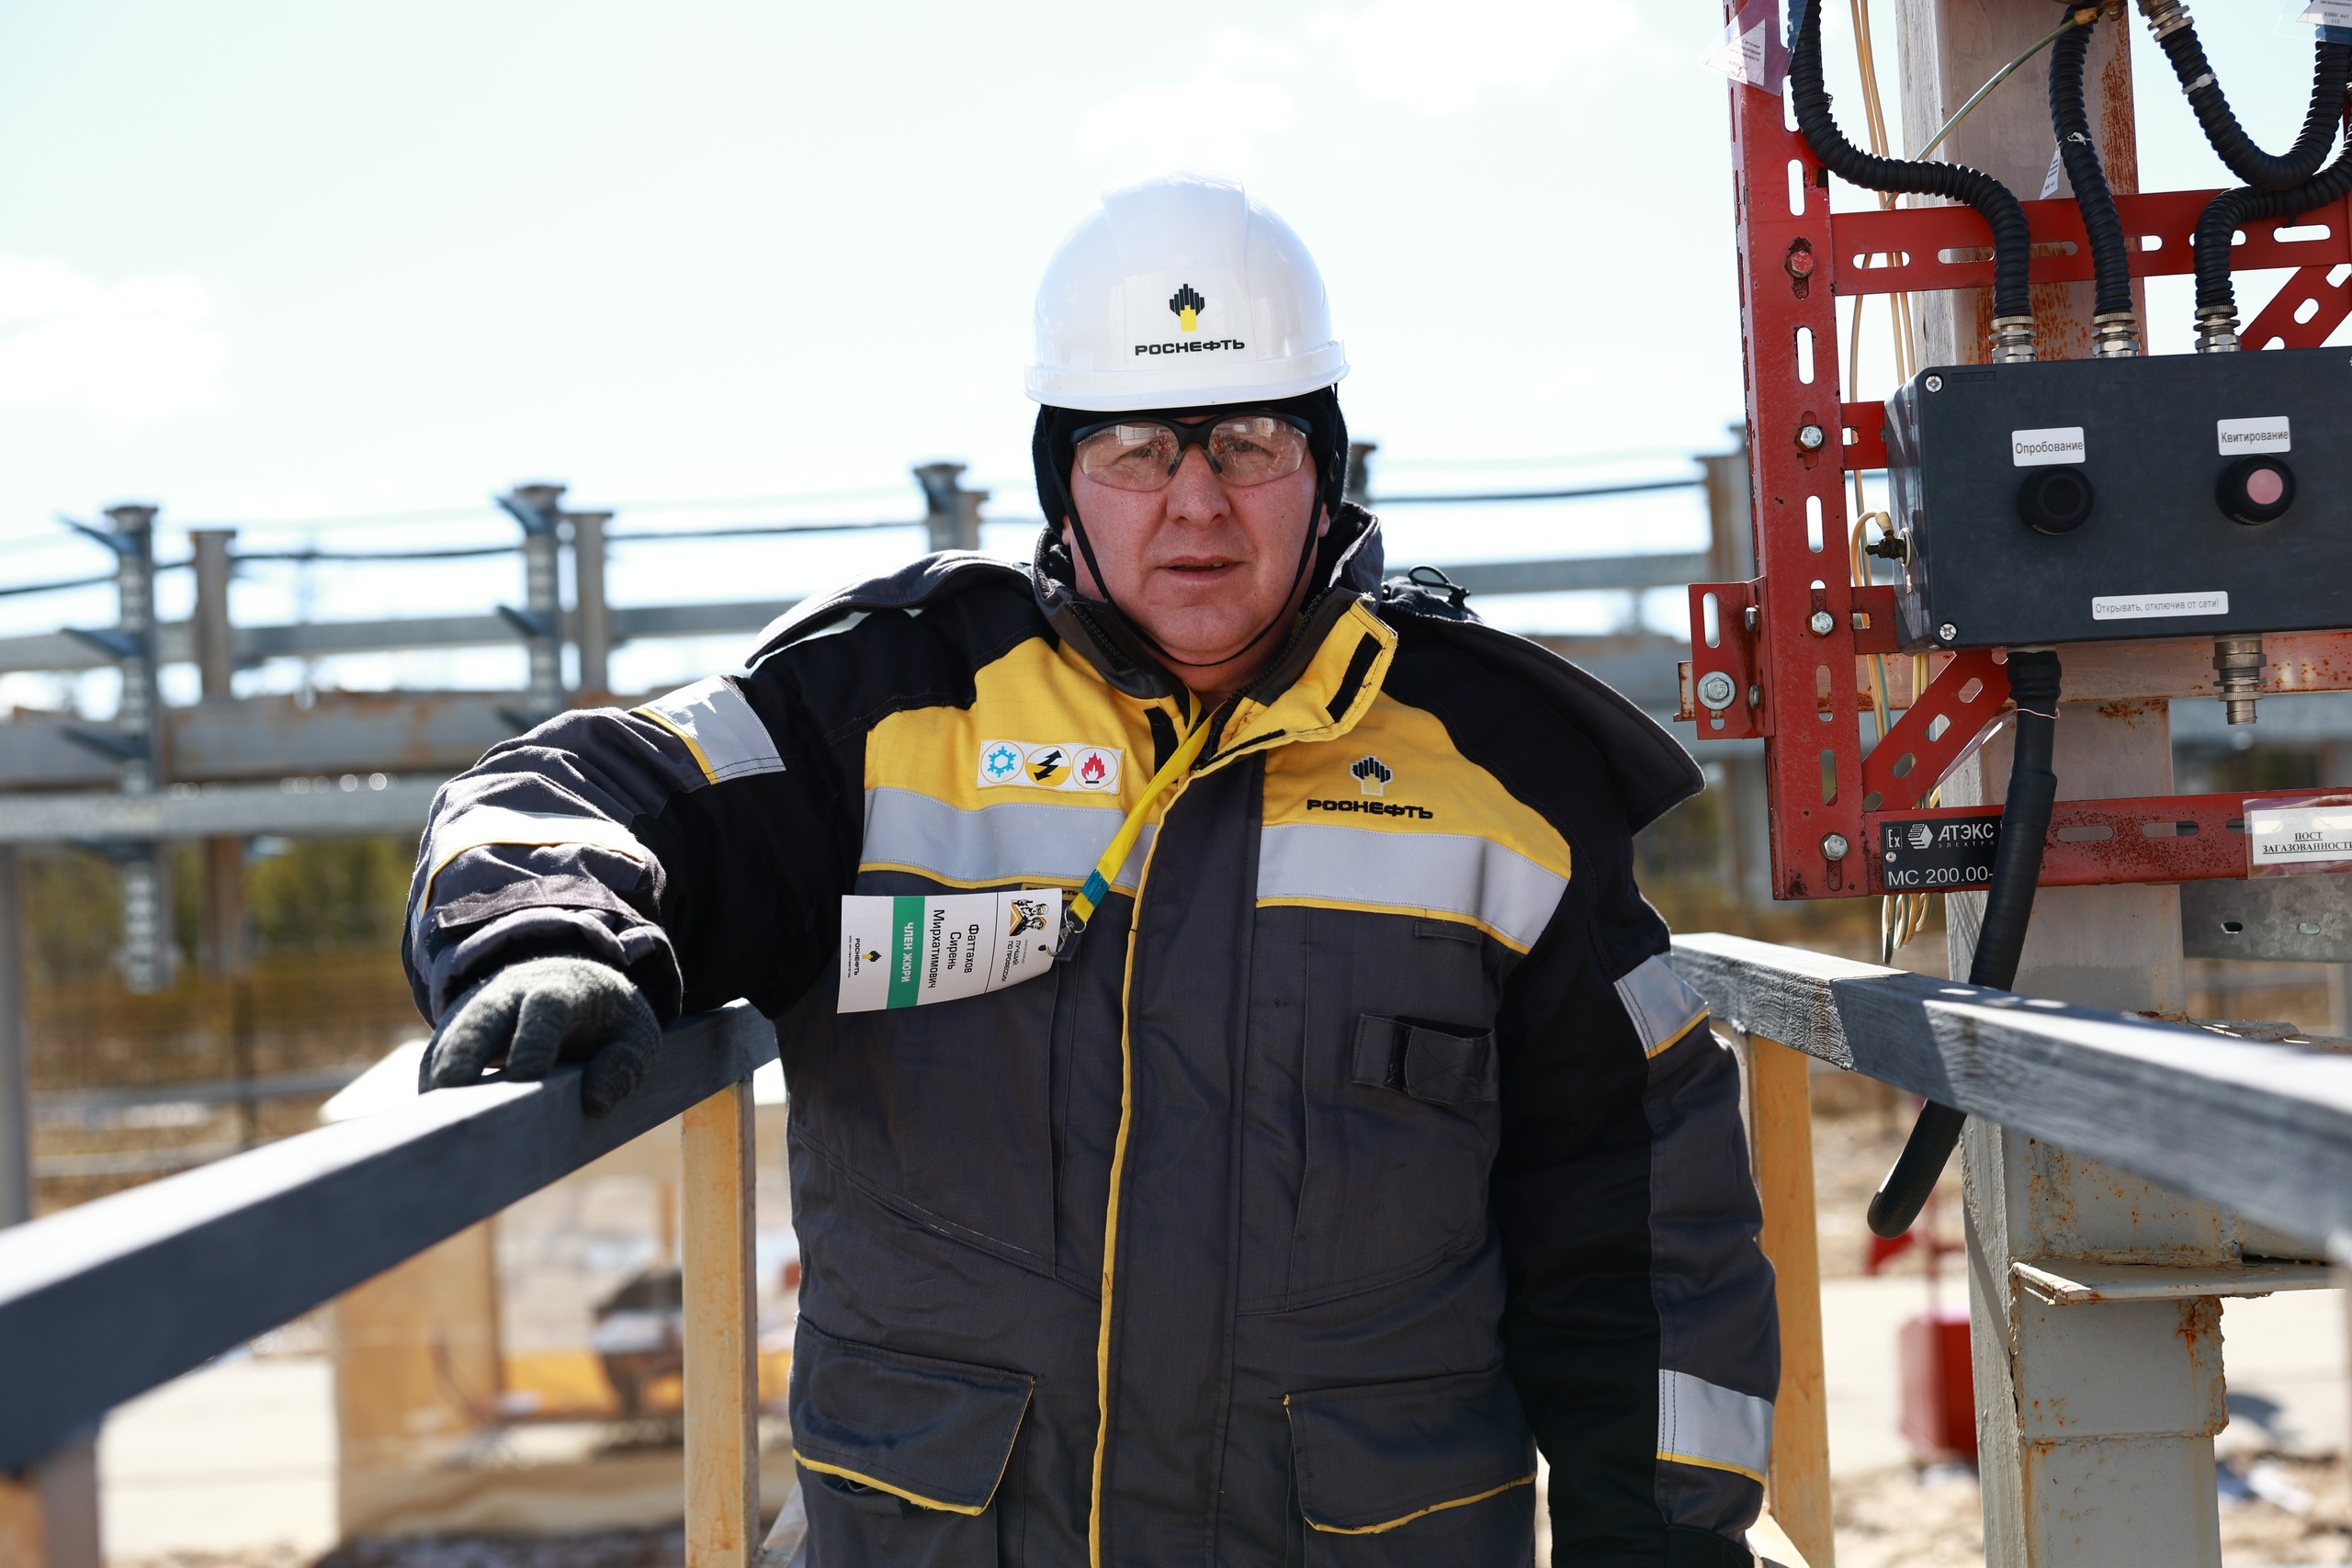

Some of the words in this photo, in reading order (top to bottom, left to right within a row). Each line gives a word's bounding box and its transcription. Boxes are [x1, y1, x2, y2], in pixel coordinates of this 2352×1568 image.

[1135, 339, 1245, 355] РОСНЕФТЬ
[2221, 431, 2290, 445] Квитирование
[2015, 441, 2084, 456] Опробование
[2095, 603, 2143, 615] Открывать,
[2144, 601, 2185, 611] отключив
[2187, 600, 2196, 609] от
[2198, 598, 2220, 608] сети!
[1306, 799, 1433, 819] РОСНЕФТЬ
[1888, 829, 1901, 848] Ex
[1938, 823, 1995, 841] АТЭКС
[2294, 831, 2323, 840] ПОСТ
[903, 922, 914, 950] ЧЛЕН
[1007, 941, 1013, 949] ПО
[928, 909, 945, 988] Мирхатимович
[946, 931, 962, 970] Сирень
[965, 924, 979, 973] Фаттахов
[1012, 940, 1021, 965] ЛУЧШИЙ
[901, 953, 912, 983] ЖЮРИ
[1001, 950, 1012, 982] ПРОФЕССИИ
